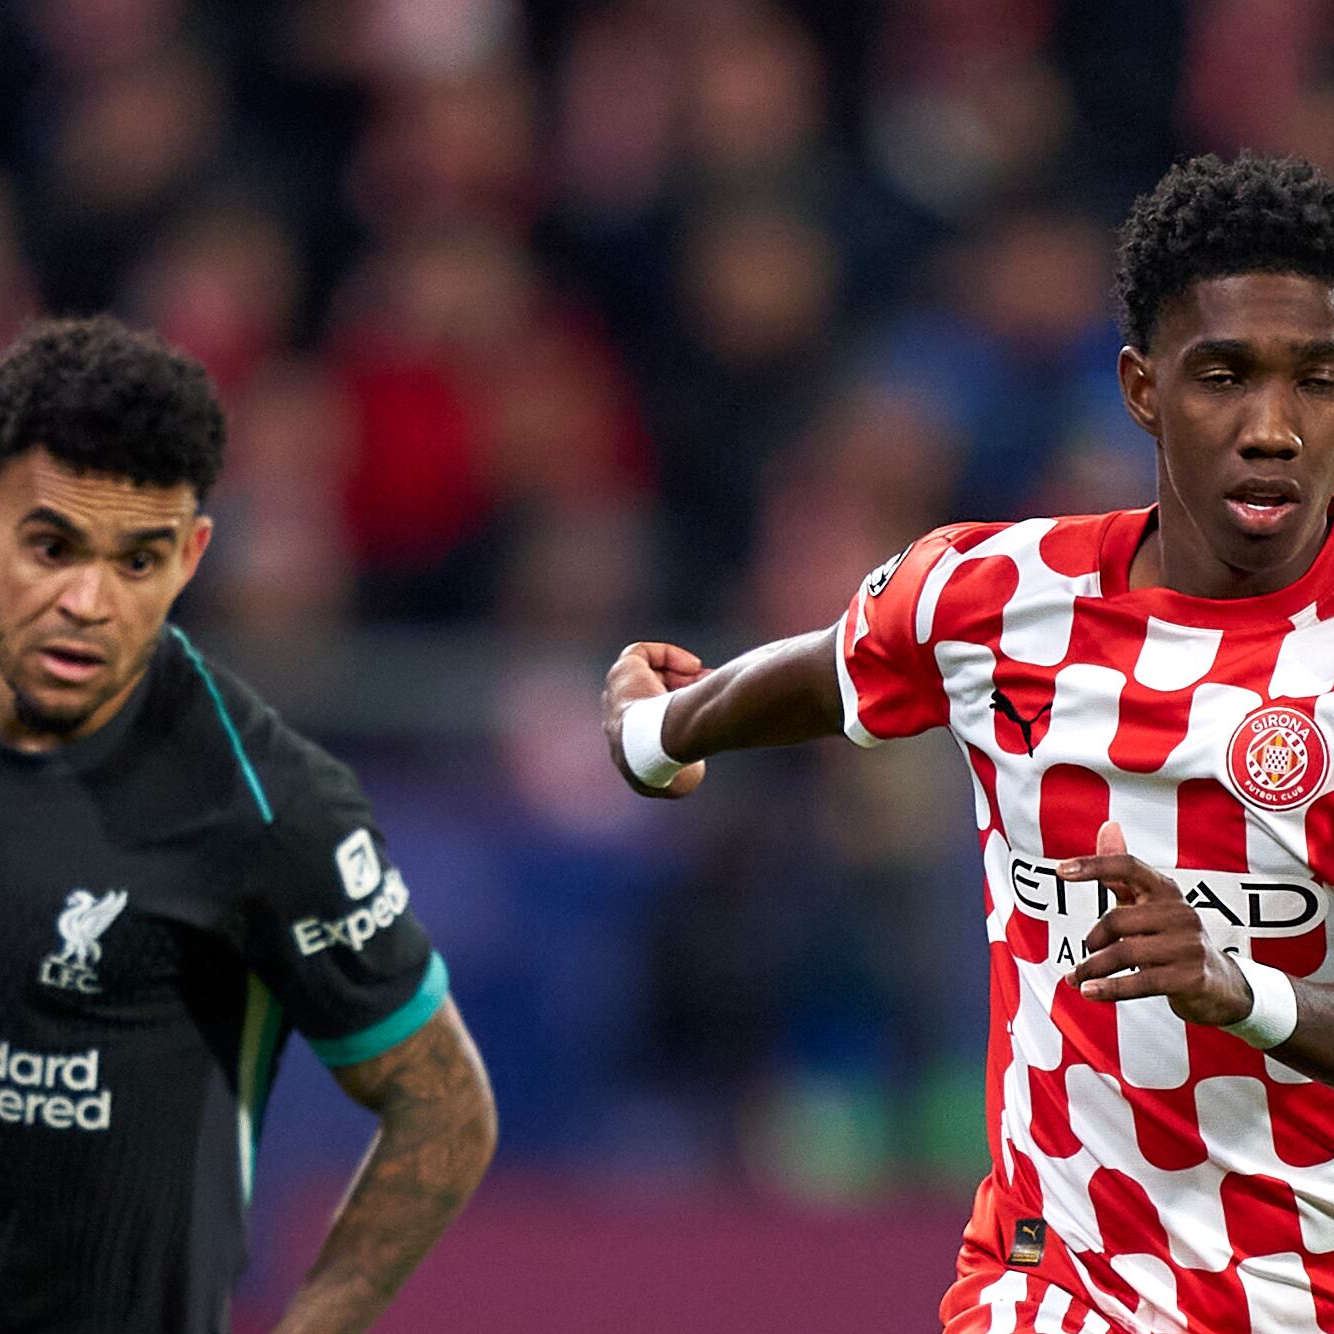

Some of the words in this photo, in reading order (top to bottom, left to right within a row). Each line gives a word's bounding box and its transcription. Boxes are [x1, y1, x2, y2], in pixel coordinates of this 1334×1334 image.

[1250, 713, 1311, 742] GIRONA
[1244, 779, 1278, 802] FUTBOL
[1280, 785, 1305, 802] CLUB
[1011, 857, 1320, 929] ETIAD
